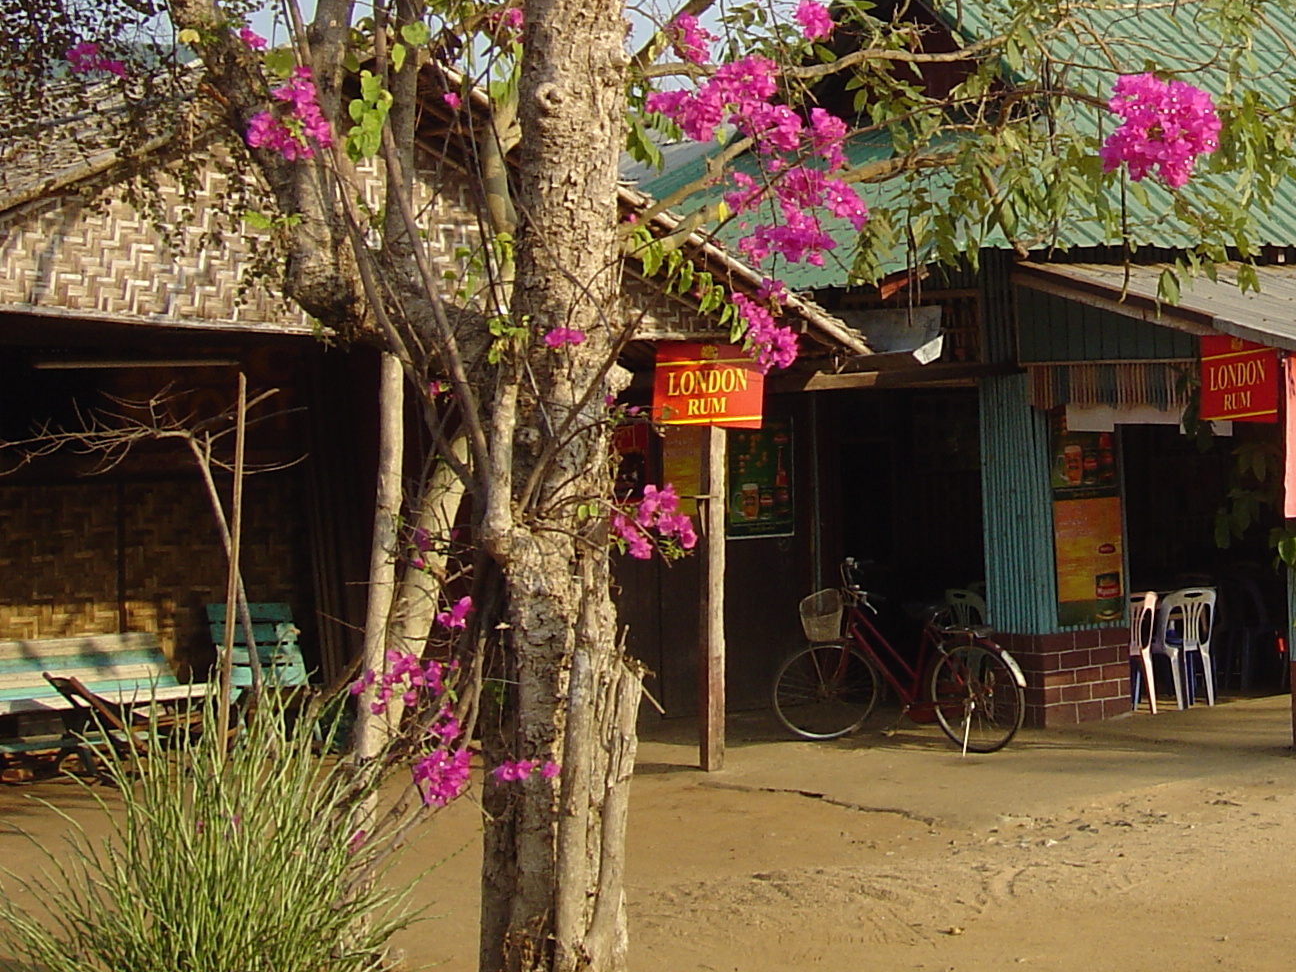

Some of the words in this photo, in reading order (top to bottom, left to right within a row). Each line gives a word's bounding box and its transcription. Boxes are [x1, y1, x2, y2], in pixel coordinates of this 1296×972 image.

[667, 368, 749, 396] LONDON
[1210, 358, 1266, 391] LONDON
[687, 397, 727, 416] RUM
[1224, 391, 1251, 411] RUM
